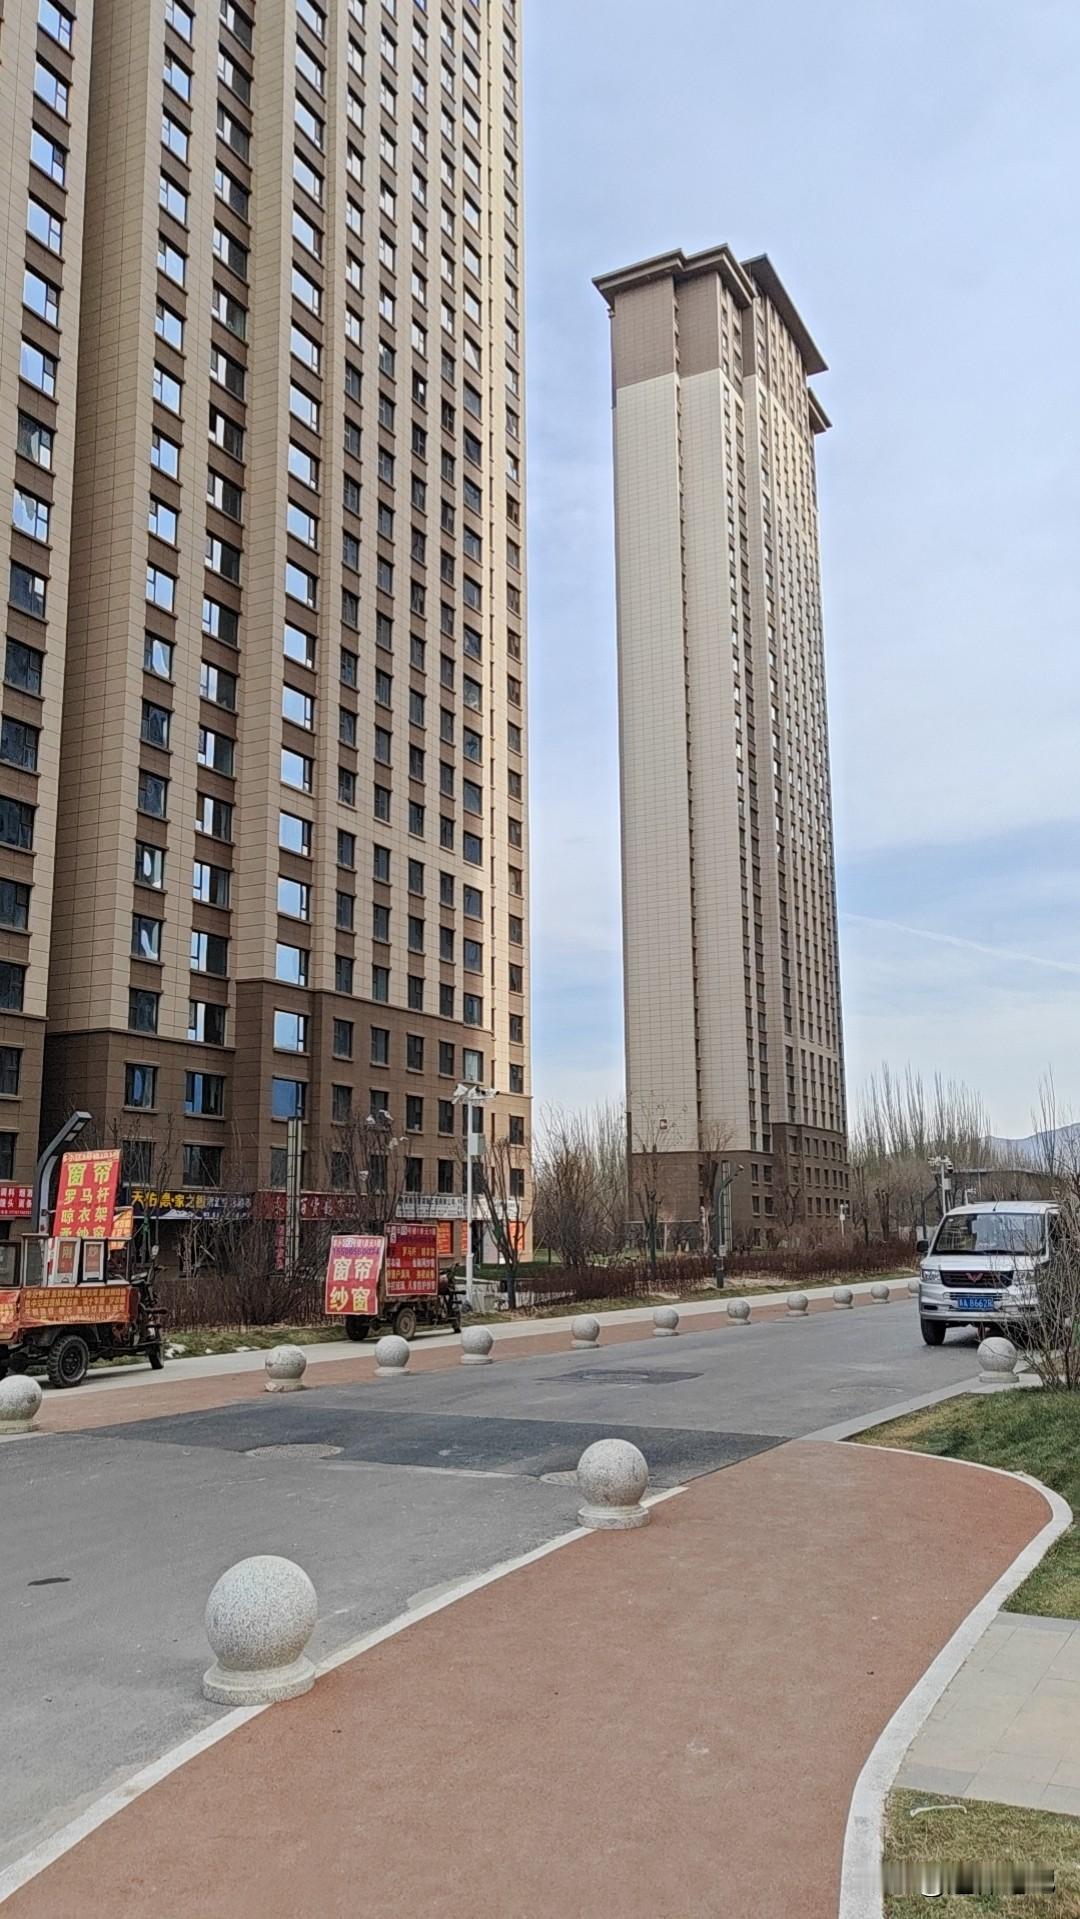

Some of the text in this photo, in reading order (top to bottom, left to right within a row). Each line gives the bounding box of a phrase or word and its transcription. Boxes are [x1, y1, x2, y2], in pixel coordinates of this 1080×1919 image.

[67, 1161, 113, 1187] 窗帘
[63, 1187, 110, 1205] 罗马杆
[61, 1206, 108, 1224] 晾衣架
[333, 1256, 374, 1282] 窗帘
[329, 1286, 371, 1312] 纱窗
